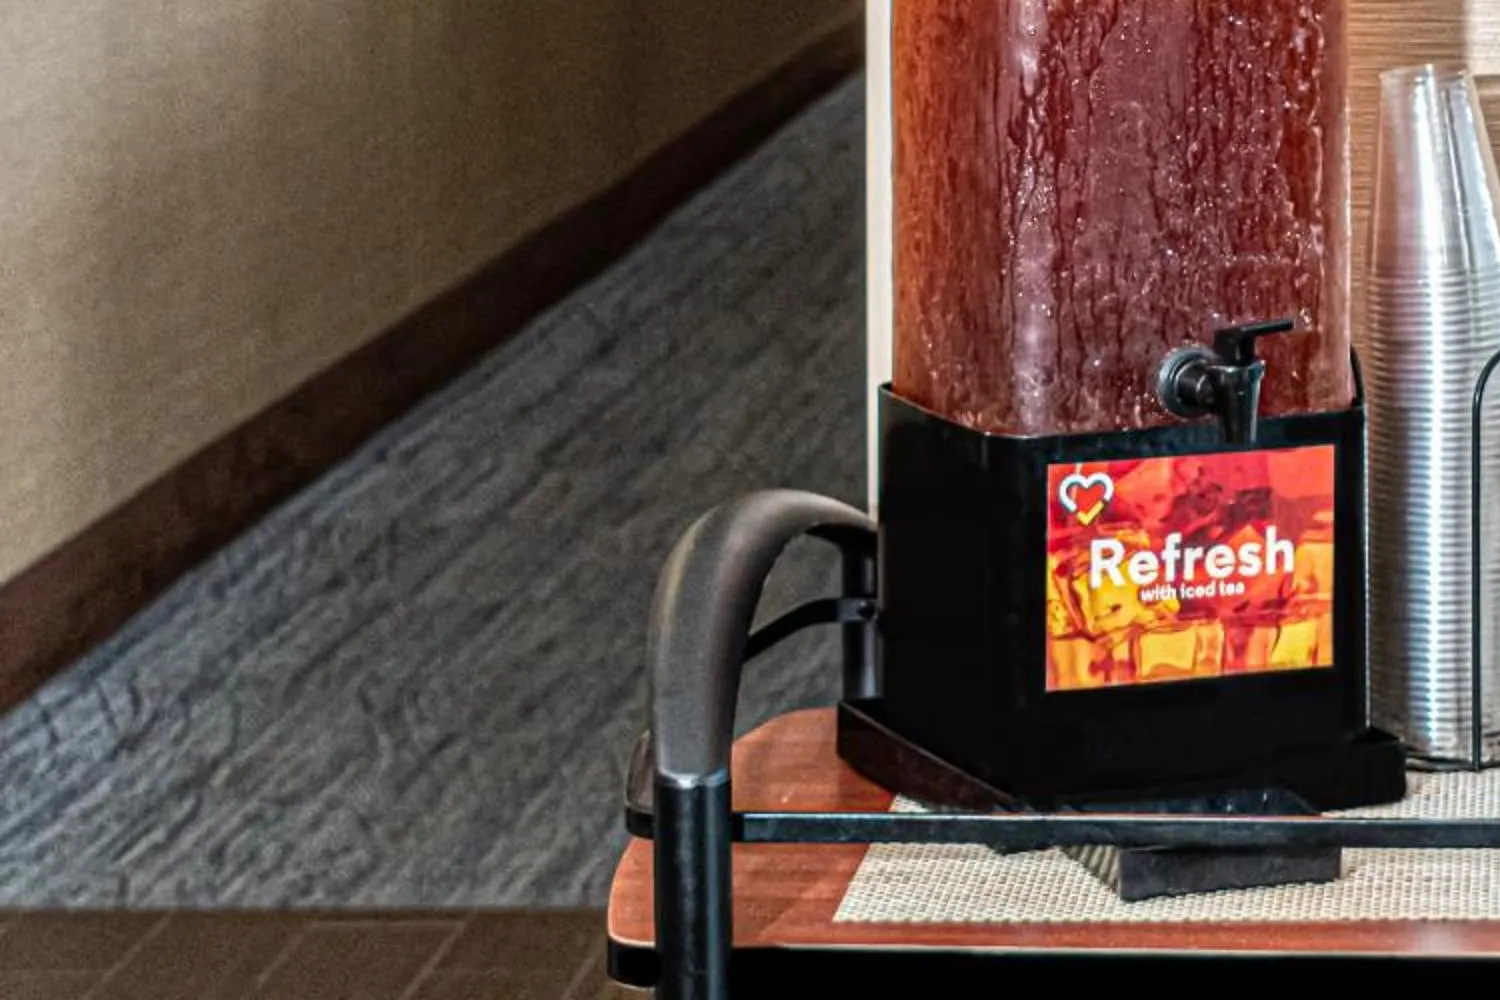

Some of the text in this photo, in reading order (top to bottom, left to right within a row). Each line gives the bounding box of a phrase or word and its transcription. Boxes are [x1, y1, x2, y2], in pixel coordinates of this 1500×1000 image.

[1089, 525, 1295, 589] Refresh
[1141, 579, 1245, 602] with iced tea
